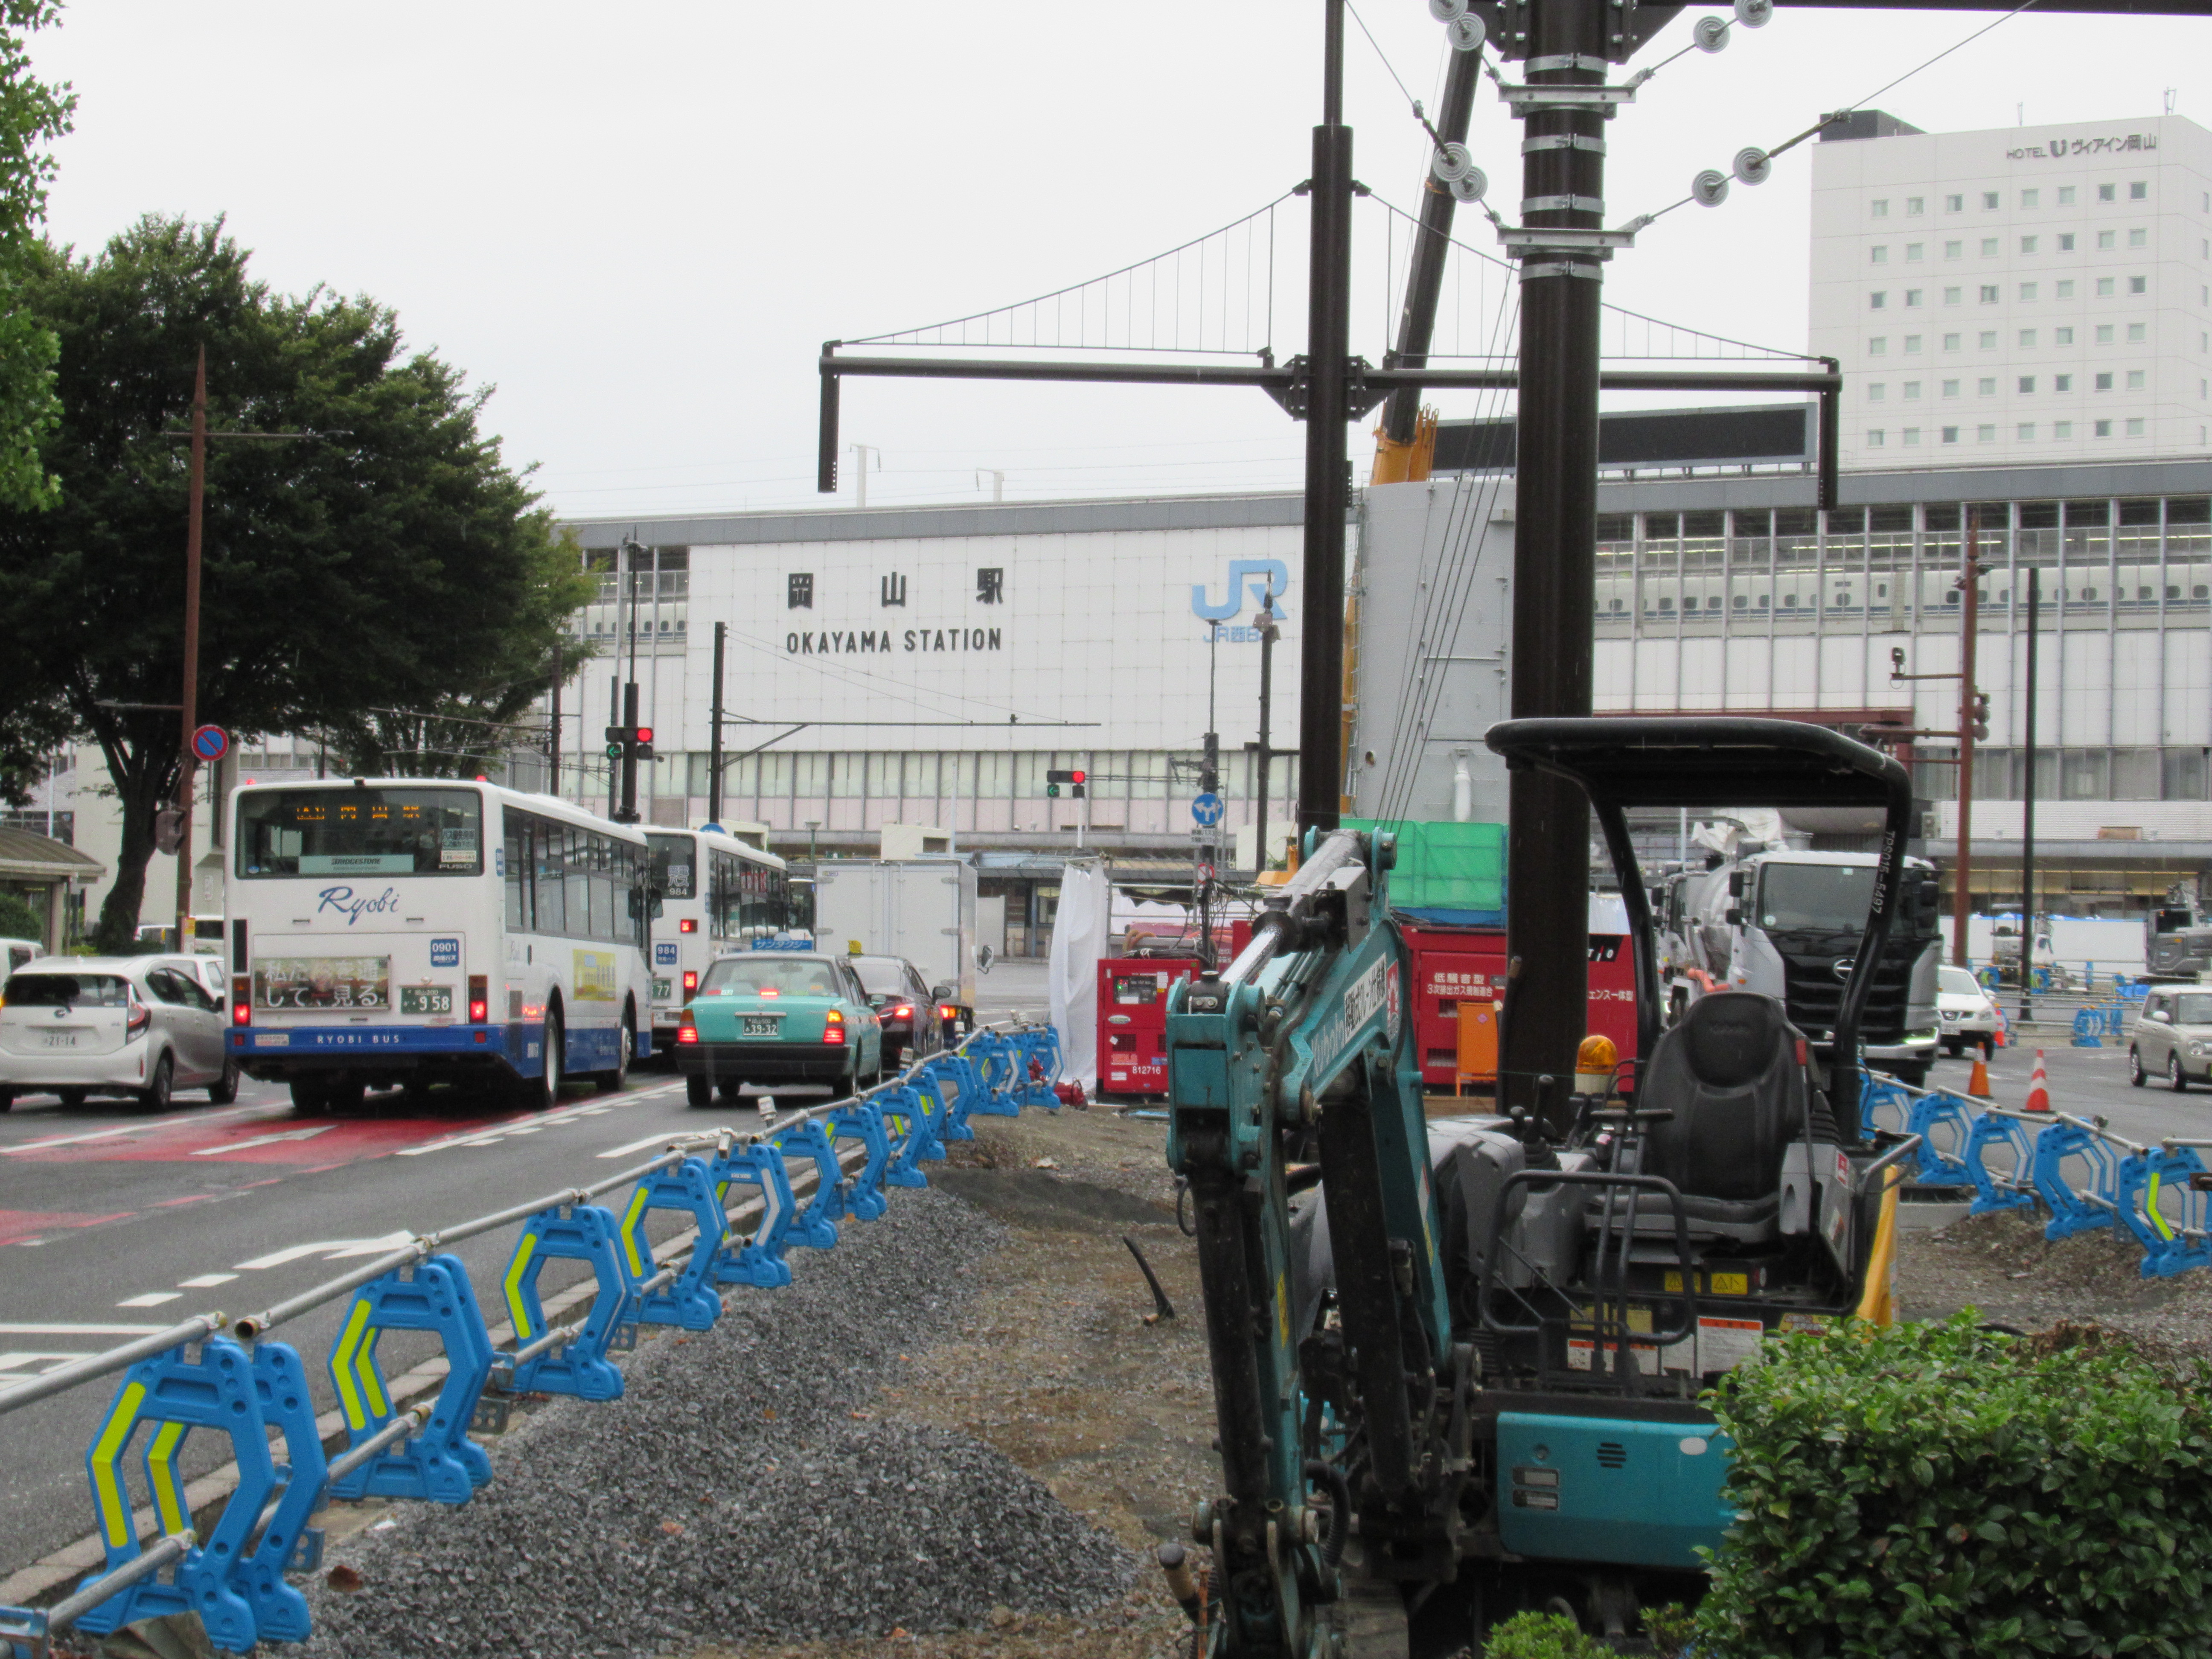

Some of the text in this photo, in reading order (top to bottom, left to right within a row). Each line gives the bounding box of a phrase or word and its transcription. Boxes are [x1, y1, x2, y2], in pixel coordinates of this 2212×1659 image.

[2006, 147, 2047, 159] HOTEL
[2072, 133, 2156, 155] ヴィアイン岡山
[788, 568, 1003, 609] 岡山駅
[1191, 559, 1288, 620] JR
[787, 628, 1001, 654] OKAYAMA STATION
[1202, 626, 1263, 643] JR西日
[668, 876, 689, 887] バス
[317, 886, 399, 926] Ryobi
[432, 942, 457, 952] 0901
[657, 946, 675, 955] 984
[317, 1035, 399, 1044] RYOBI BUS
[1132, 1066, 1161, 1074] 812716
